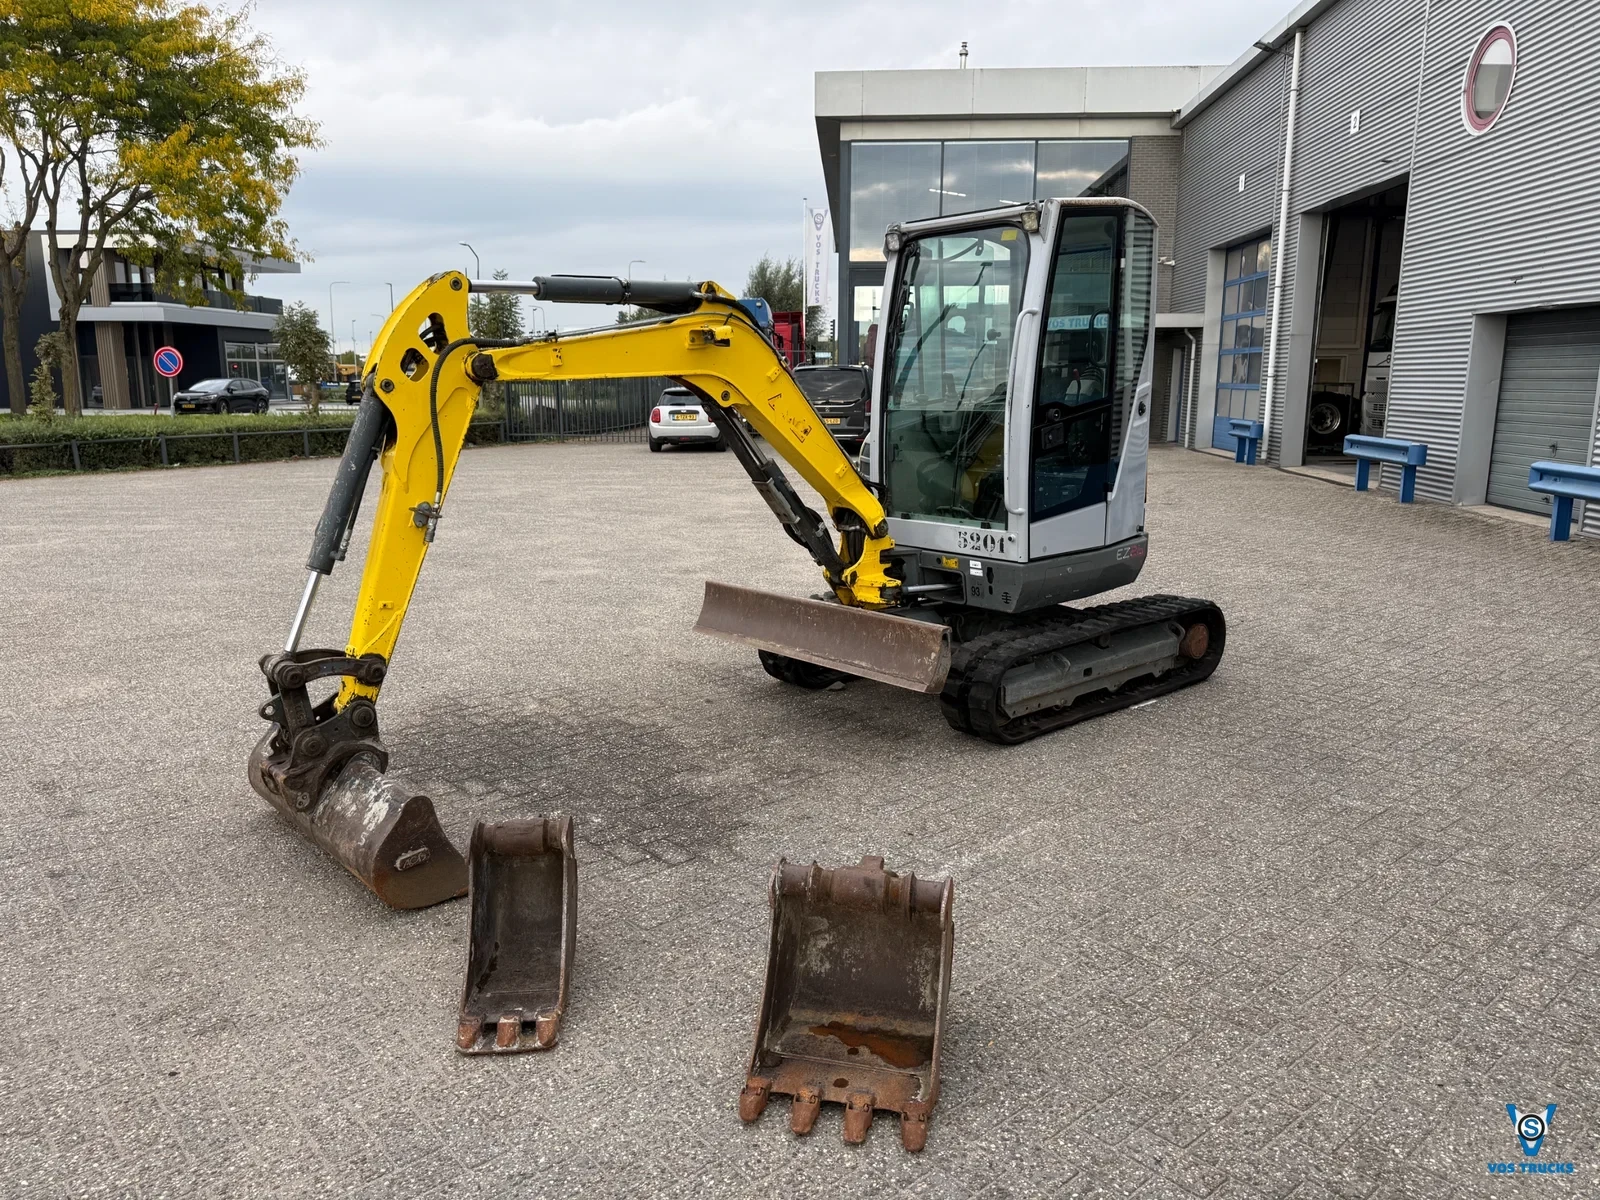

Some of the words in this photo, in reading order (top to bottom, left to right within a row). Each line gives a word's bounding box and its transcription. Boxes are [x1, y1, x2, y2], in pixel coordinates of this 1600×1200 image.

[1068, 316, 1108, 328] TRUKS
[957, 531, 1005, 553] 5201
[971, 586, 980, 597] 93
